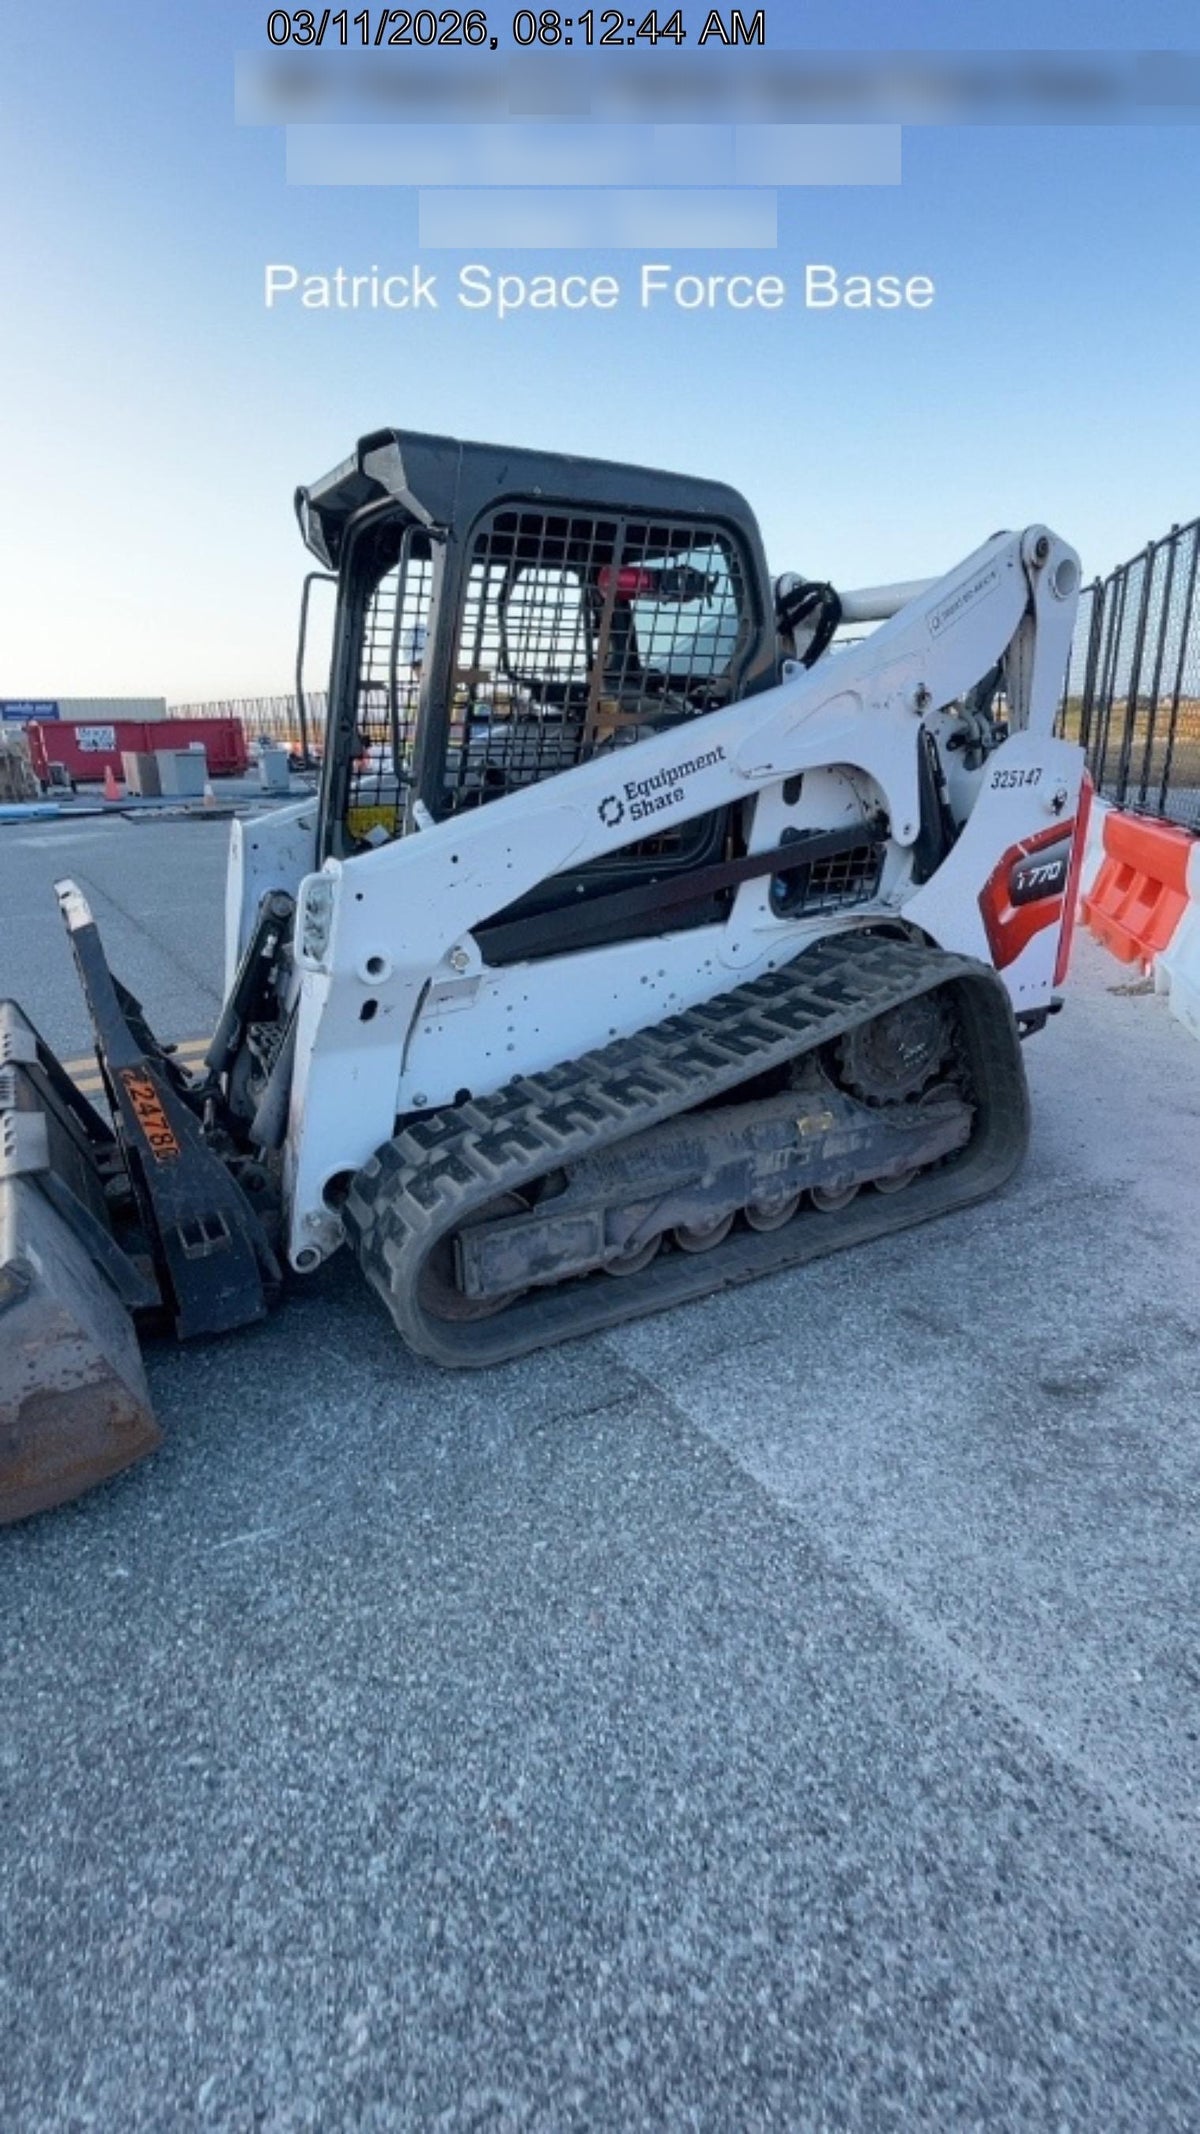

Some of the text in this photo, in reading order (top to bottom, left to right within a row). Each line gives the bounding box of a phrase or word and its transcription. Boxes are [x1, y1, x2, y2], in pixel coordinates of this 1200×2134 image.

[623, 745, 727, 801] Equipment
[990, 767, 1043, 790] 325147
[629, 786, 685, 821] Share
